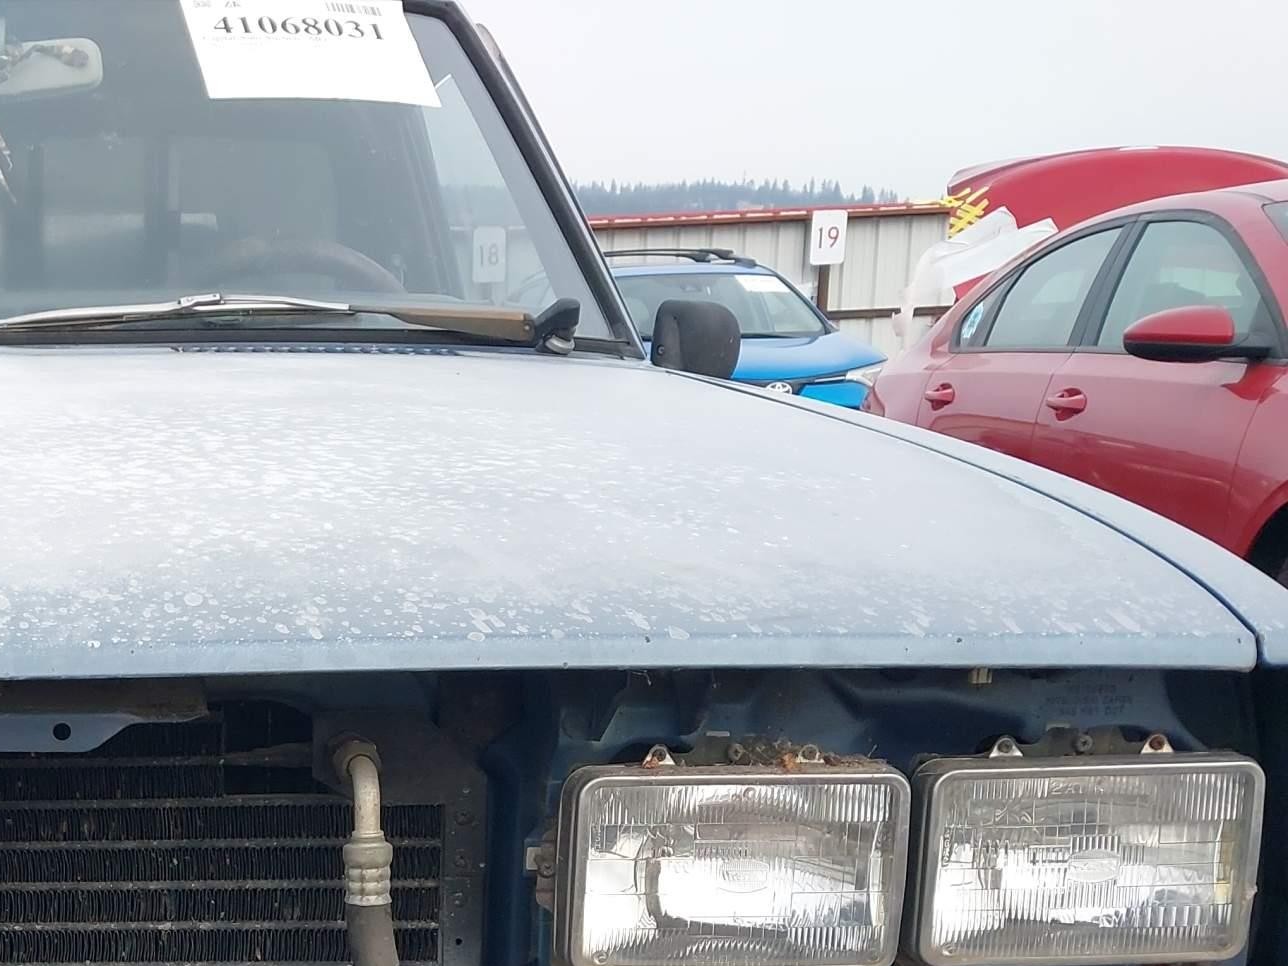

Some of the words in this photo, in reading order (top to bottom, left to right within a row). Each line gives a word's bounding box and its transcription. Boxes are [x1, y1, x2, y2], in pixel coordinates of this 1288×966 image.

[213, 16, 385, 40] 41068031
[818, 226, 840, 249] 19
[479, 243, 499, 267] 18
